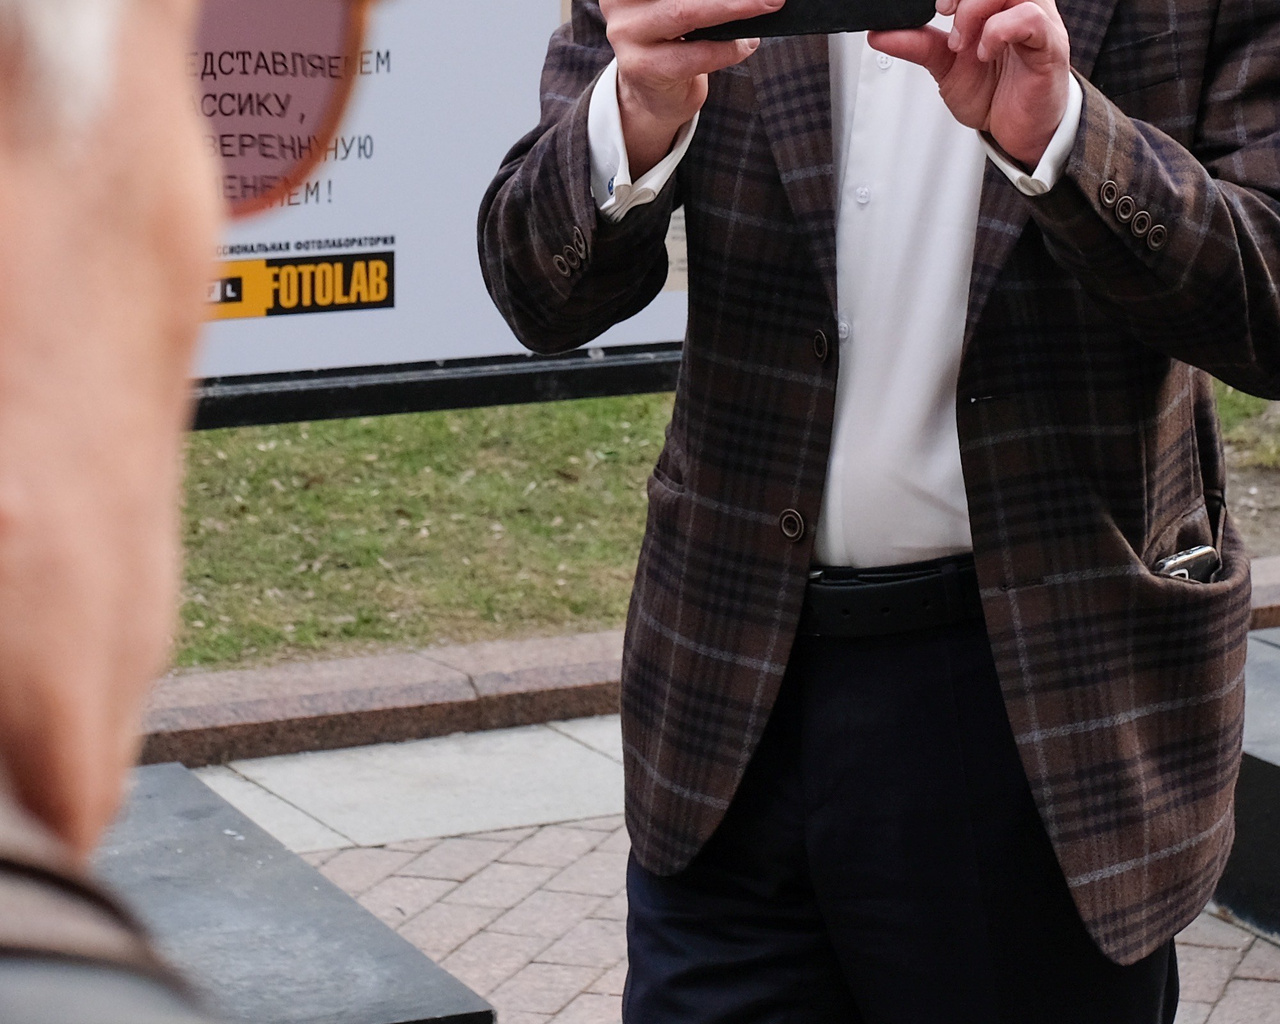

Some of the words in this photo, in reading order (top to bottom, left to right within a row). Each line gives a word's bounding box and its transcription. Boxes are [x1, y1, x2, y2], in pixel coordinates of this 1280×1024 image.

[198, 91, 306, 125] ССИКУ,
[217, 241, 291, 256] ССИОНАЛЬНАЯ
[266, 258, 390, 310] FOTOLAB
